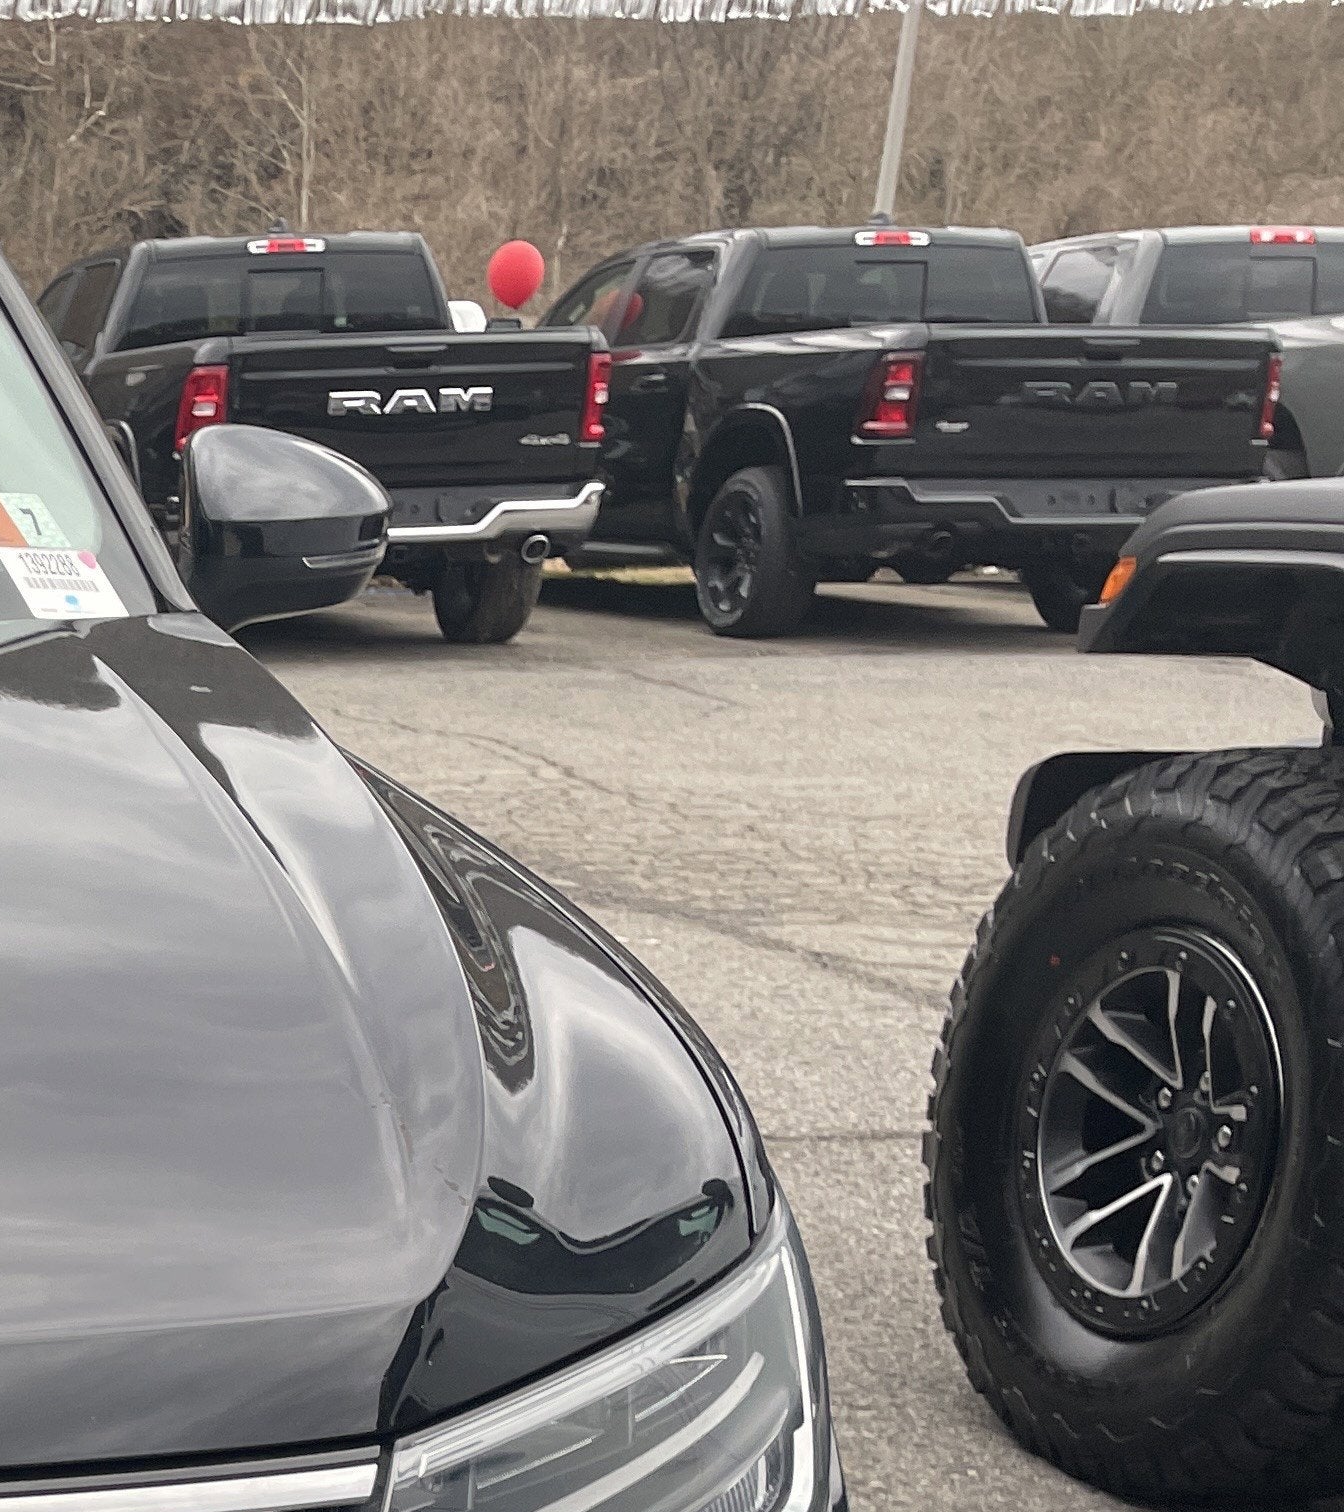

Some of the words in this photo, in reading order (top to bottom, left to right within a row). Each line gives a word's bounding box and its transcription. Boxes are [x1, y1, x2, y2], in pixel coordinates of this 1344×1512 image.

[327, 386, 493, 416] RAM
[1020, 380, 1178, 404] RAM
[18, 507, 42, 536] 7
